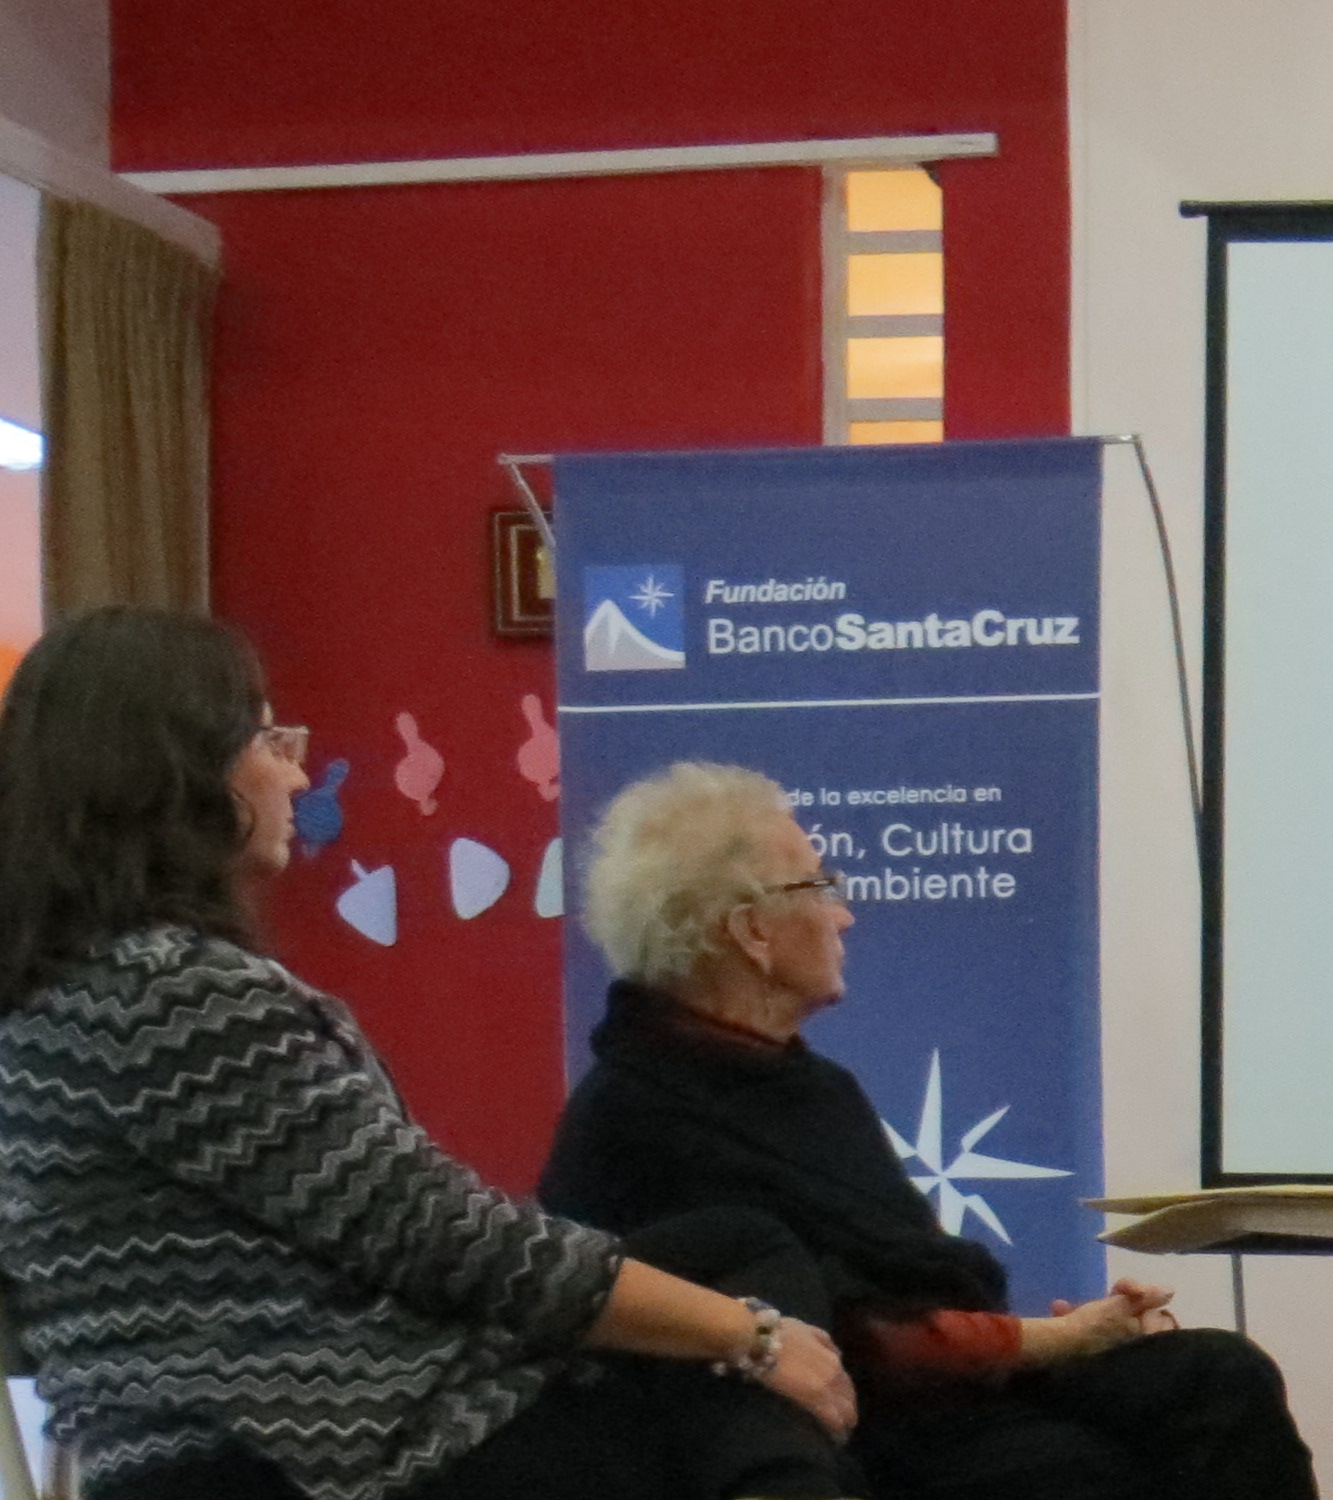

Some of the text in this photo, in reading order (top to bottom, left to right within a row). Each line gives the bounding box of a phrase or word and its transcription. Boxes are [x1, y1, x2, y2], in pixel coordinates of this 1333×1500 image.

[704, 576, 847, 604] Fundación
[708, 608, 1081, 655] BancoSantaCruz
[786, 784, 1002, 806] de la excelencia en
[806, 822, 1033, 859] ón, Cultura
[840, 866, 1016, 901] mbiente
